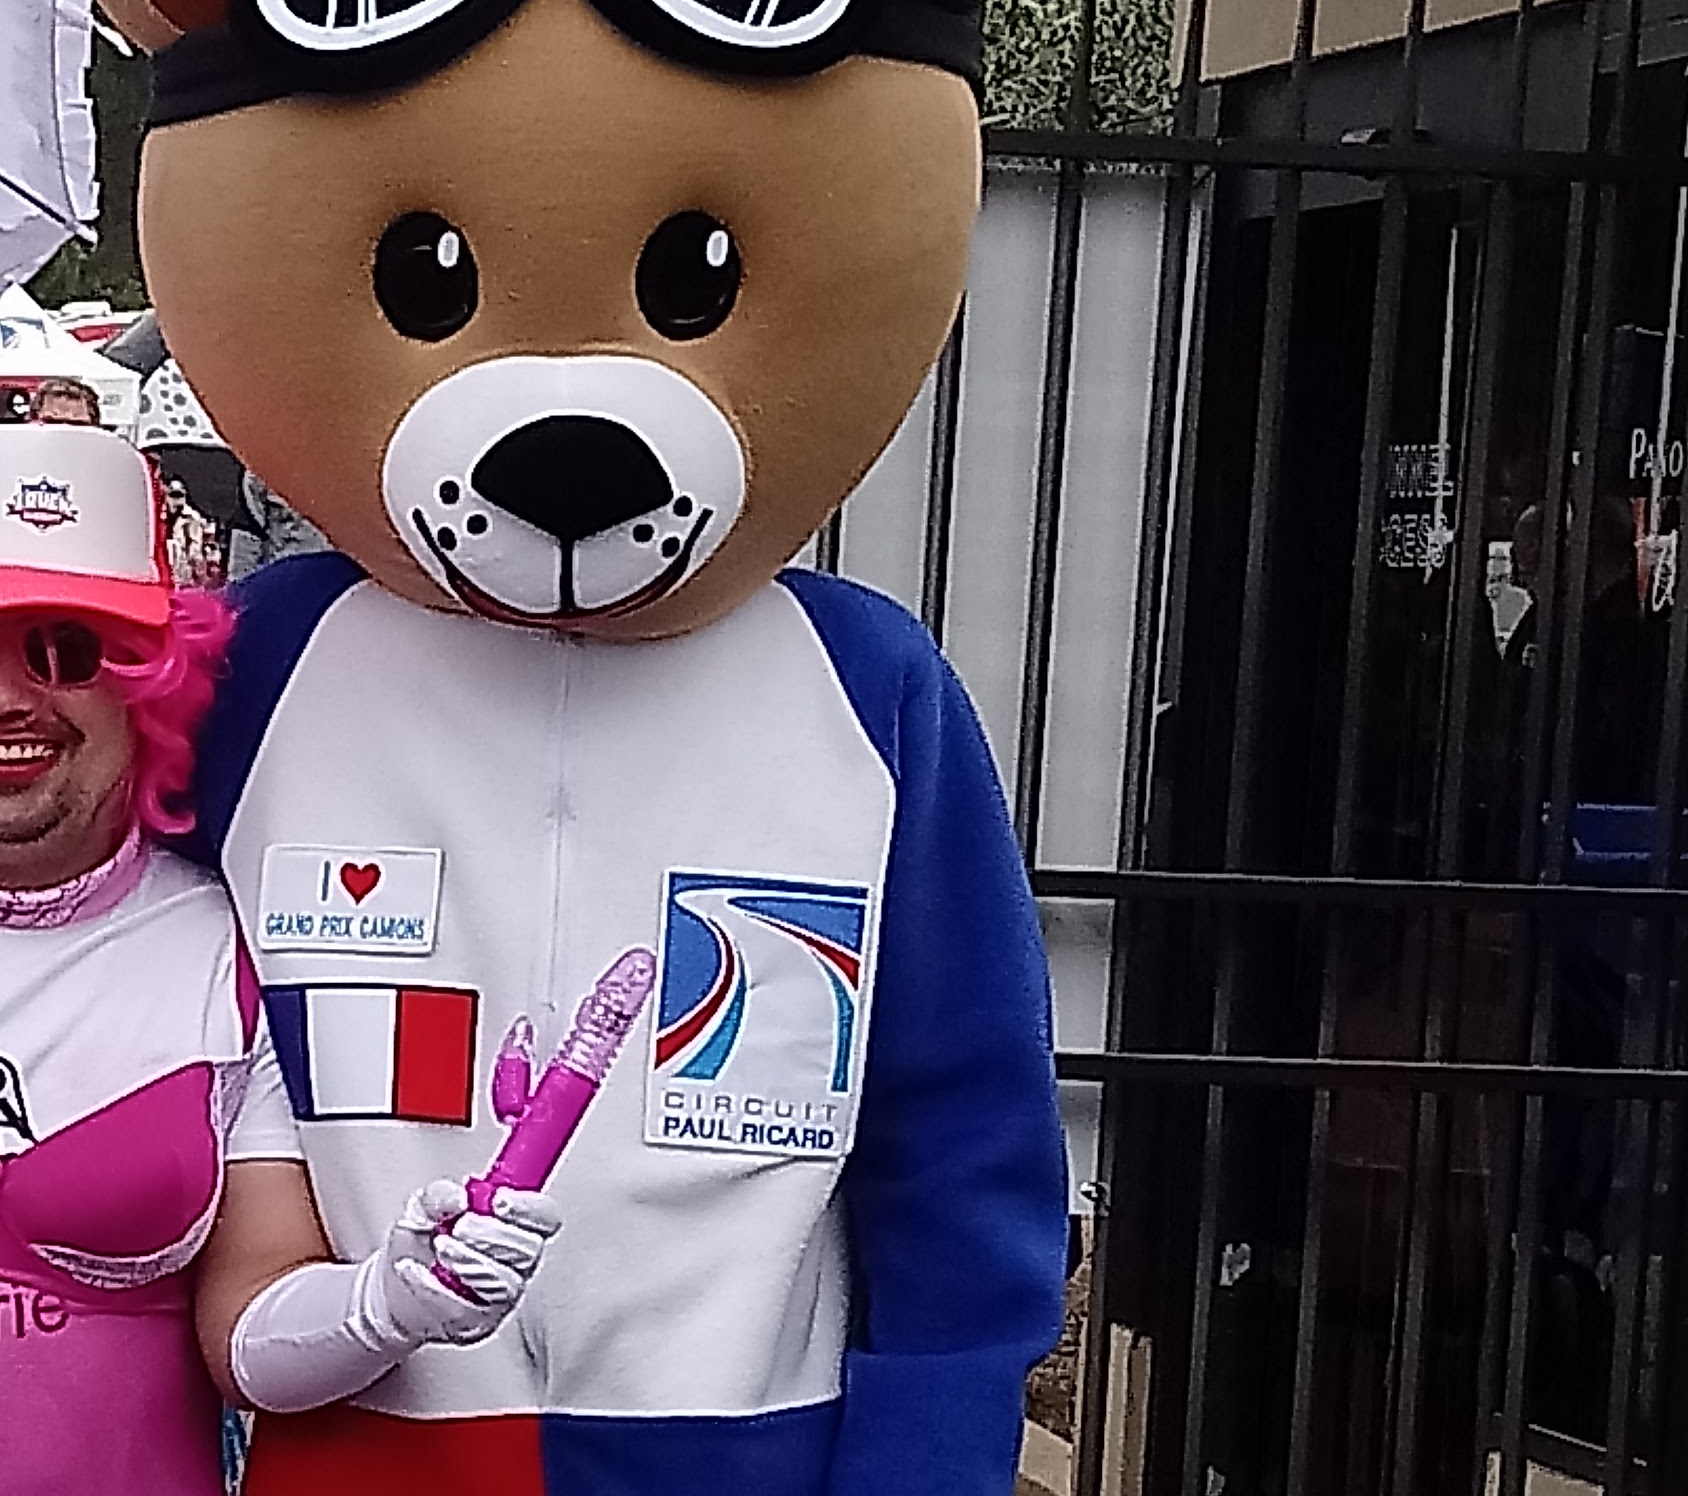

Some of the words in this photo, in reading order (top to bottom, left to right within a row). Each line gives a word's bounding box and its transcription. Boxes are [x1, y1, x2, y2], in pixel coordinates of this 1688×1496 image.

[320, 860, 331, 902] I
[265, 912, 314, 937] GRAND
[319, 914, 355, 938] PRIX
[664, 1091, 839, 1122] CIRCUIT
[664, 1116, 733, 1141] PAUL
[740, 1122, 834, 1150] RICARD
